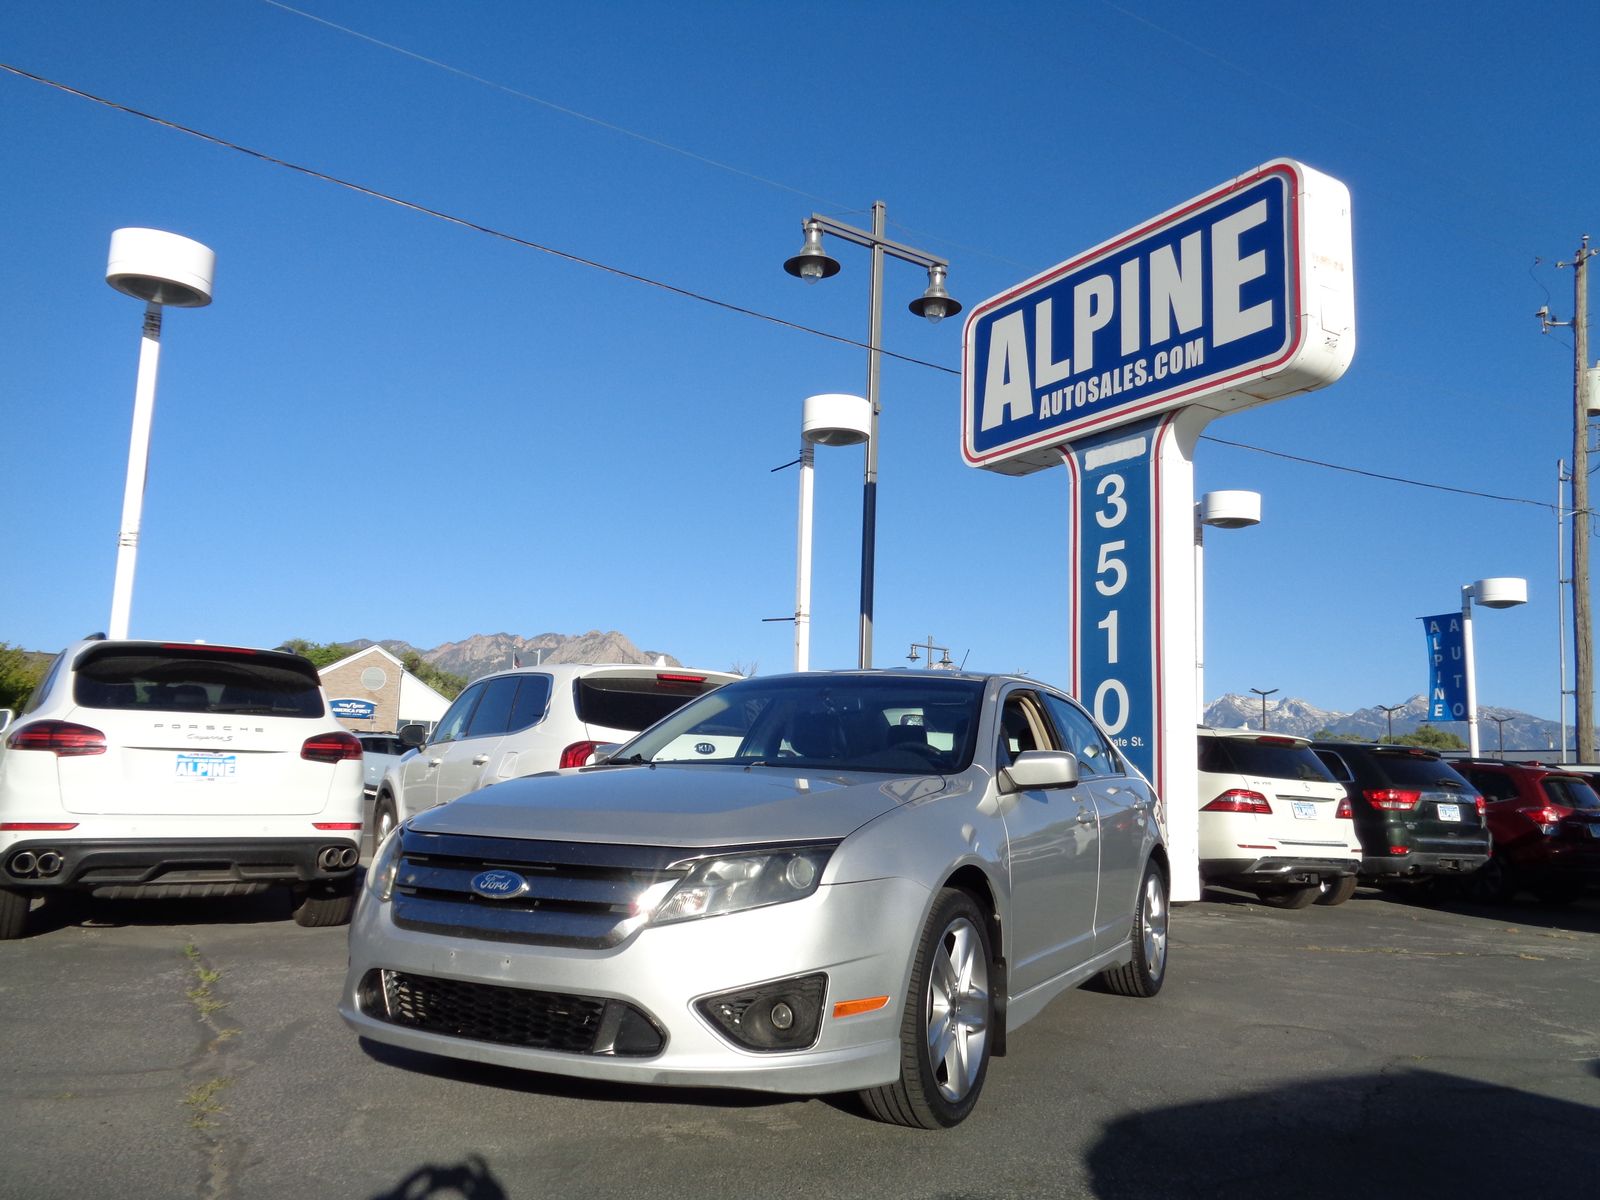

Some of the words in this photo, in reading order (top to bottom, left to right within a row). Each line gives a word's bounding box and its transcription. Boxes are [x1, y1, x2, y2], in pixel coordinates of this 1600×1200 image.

[981, 198, 1273, 432] ALPINE
[1039, 337, 1204, 420] AUTOSALES.COM
[1430, 620, 1445, 717] ALPINE
[1449, 618, 1465, 717] AUTO
[154, 723, 264, 733] PORSCHE
[1110, 737, 1128, 747] ate
[1131, 736, 1144, 747] St.
[176, 762, 236, 777] ALPINE
[480, 873, 511, 892] Ford
